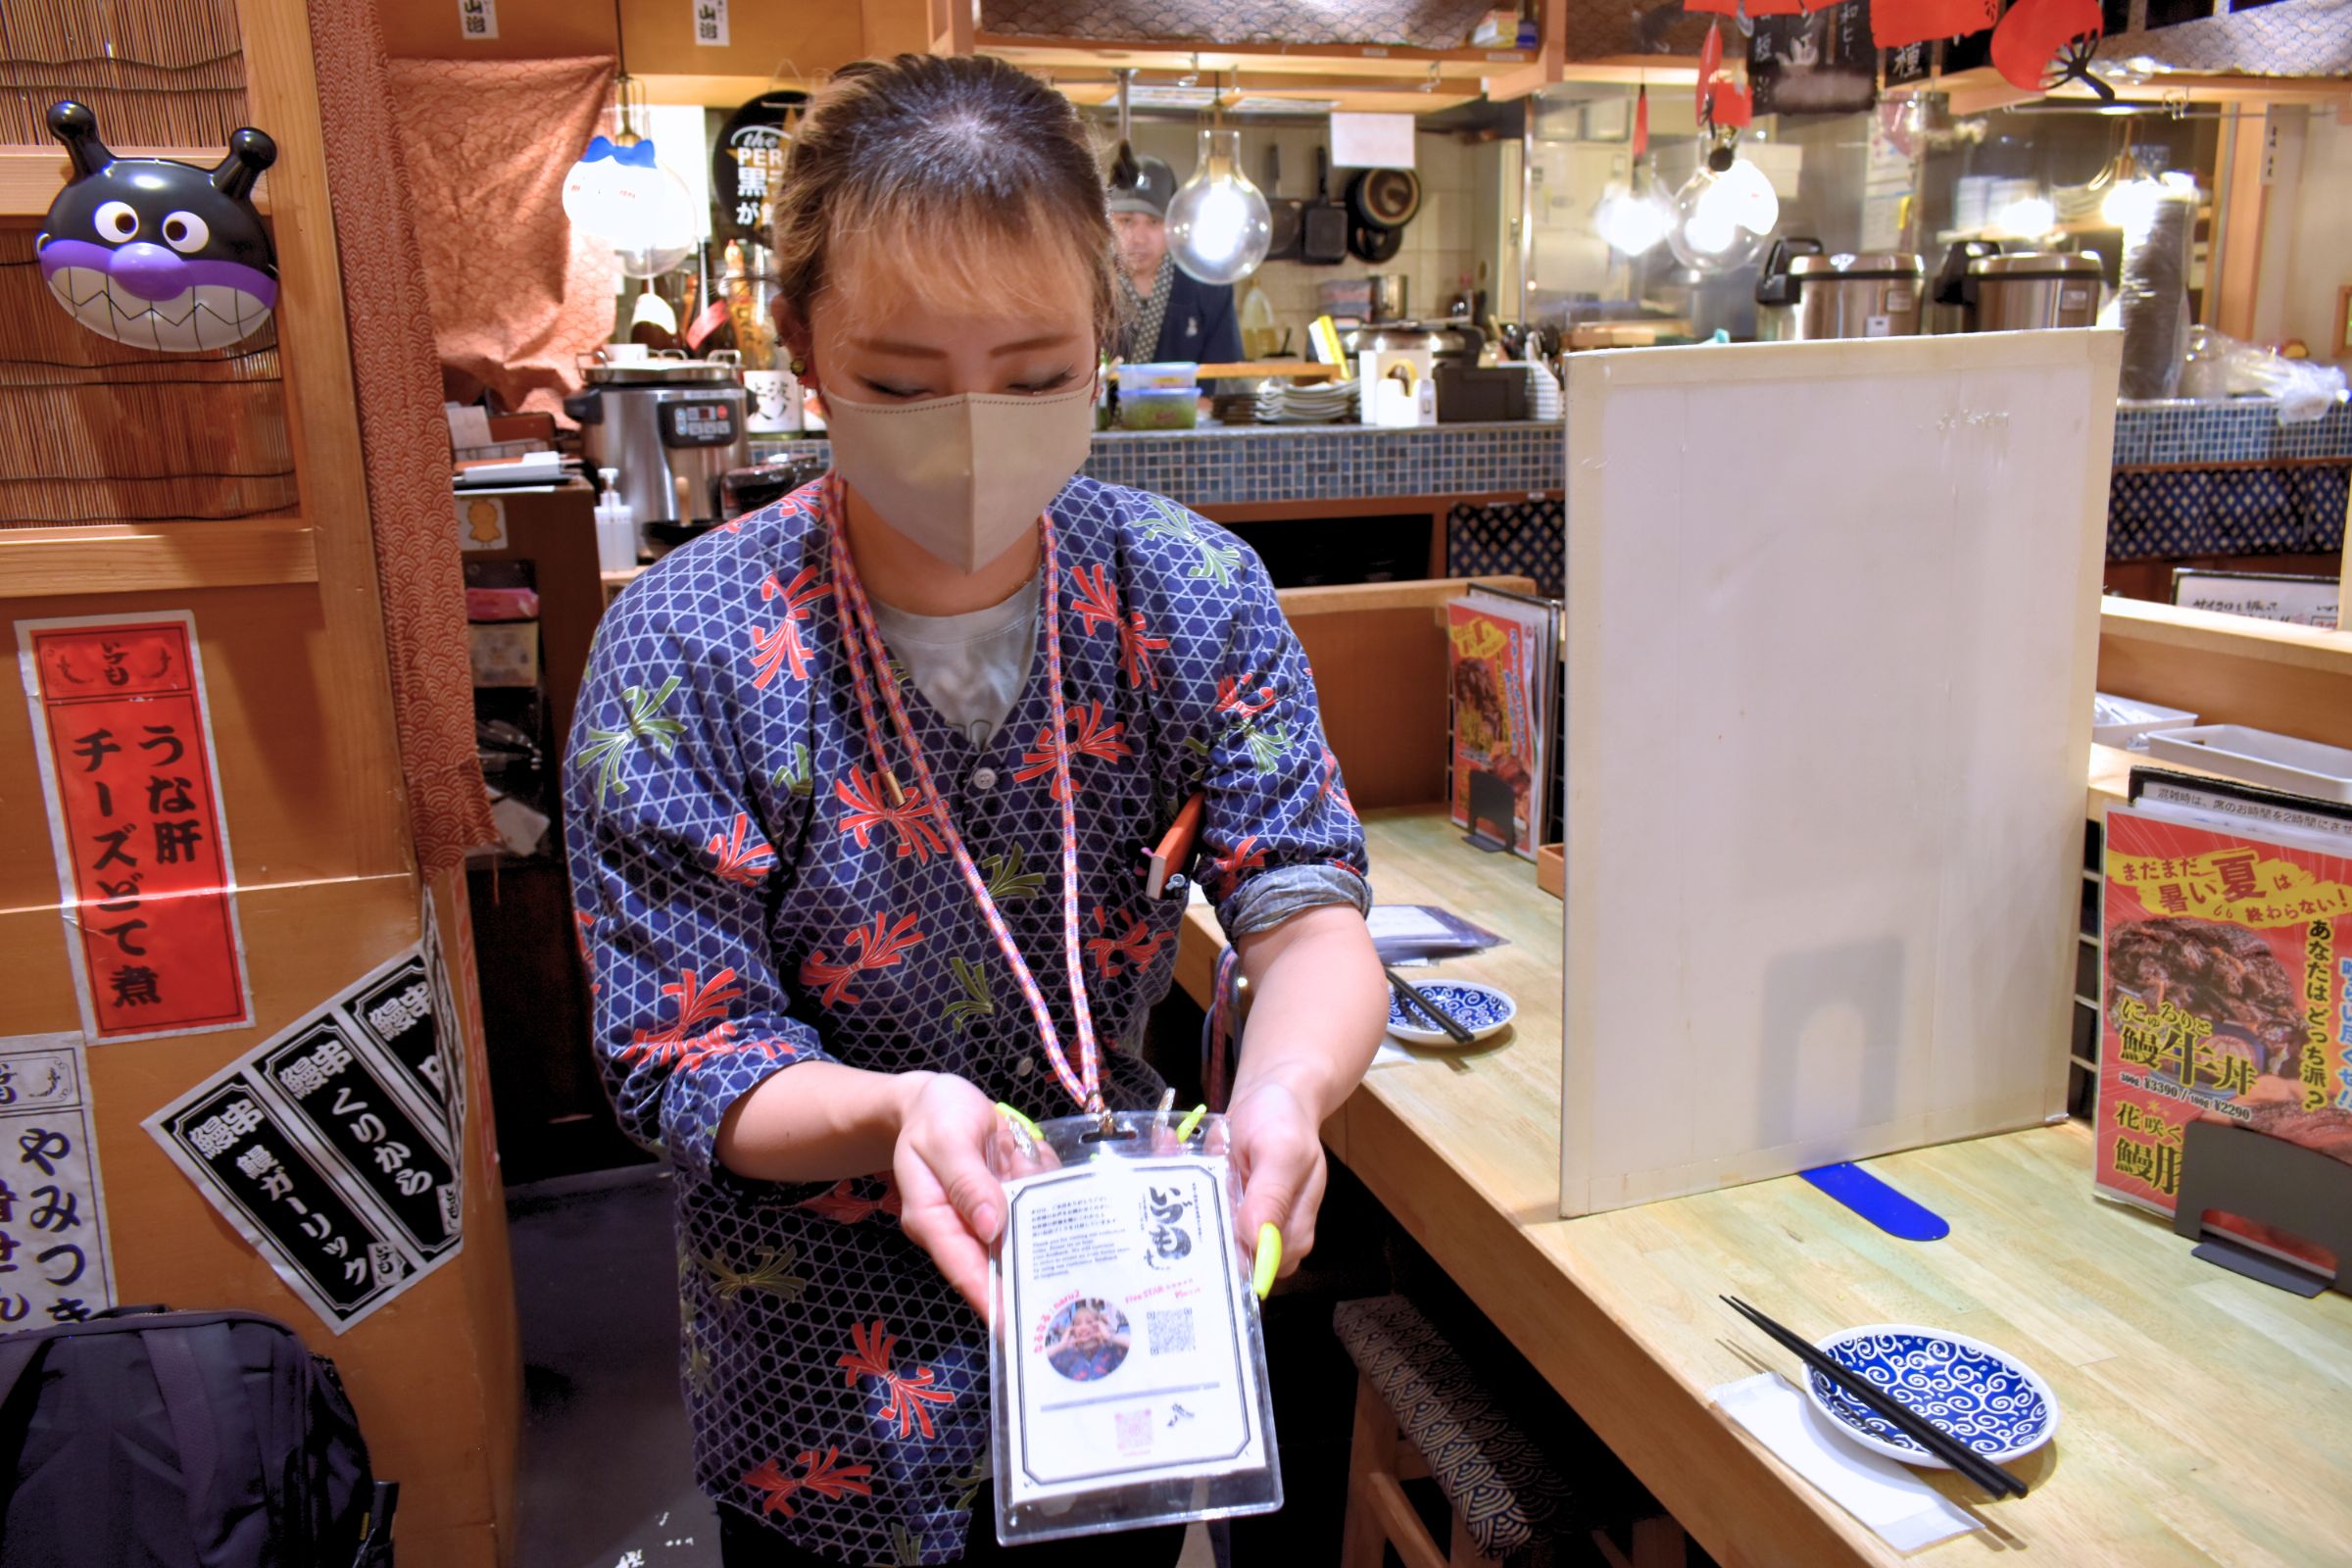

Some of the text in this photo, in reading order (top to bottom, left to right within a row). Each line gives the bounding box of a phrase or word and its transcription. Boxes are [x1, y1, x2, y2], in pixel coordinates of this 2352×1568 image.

[139, 725, 202, 864] うな肝
[73, 728, 163, 1008] チーズどて煮
[2123, 858, 2198, 882] まだまだ
[2116, 1102, 2181, 1143] 花咲く
